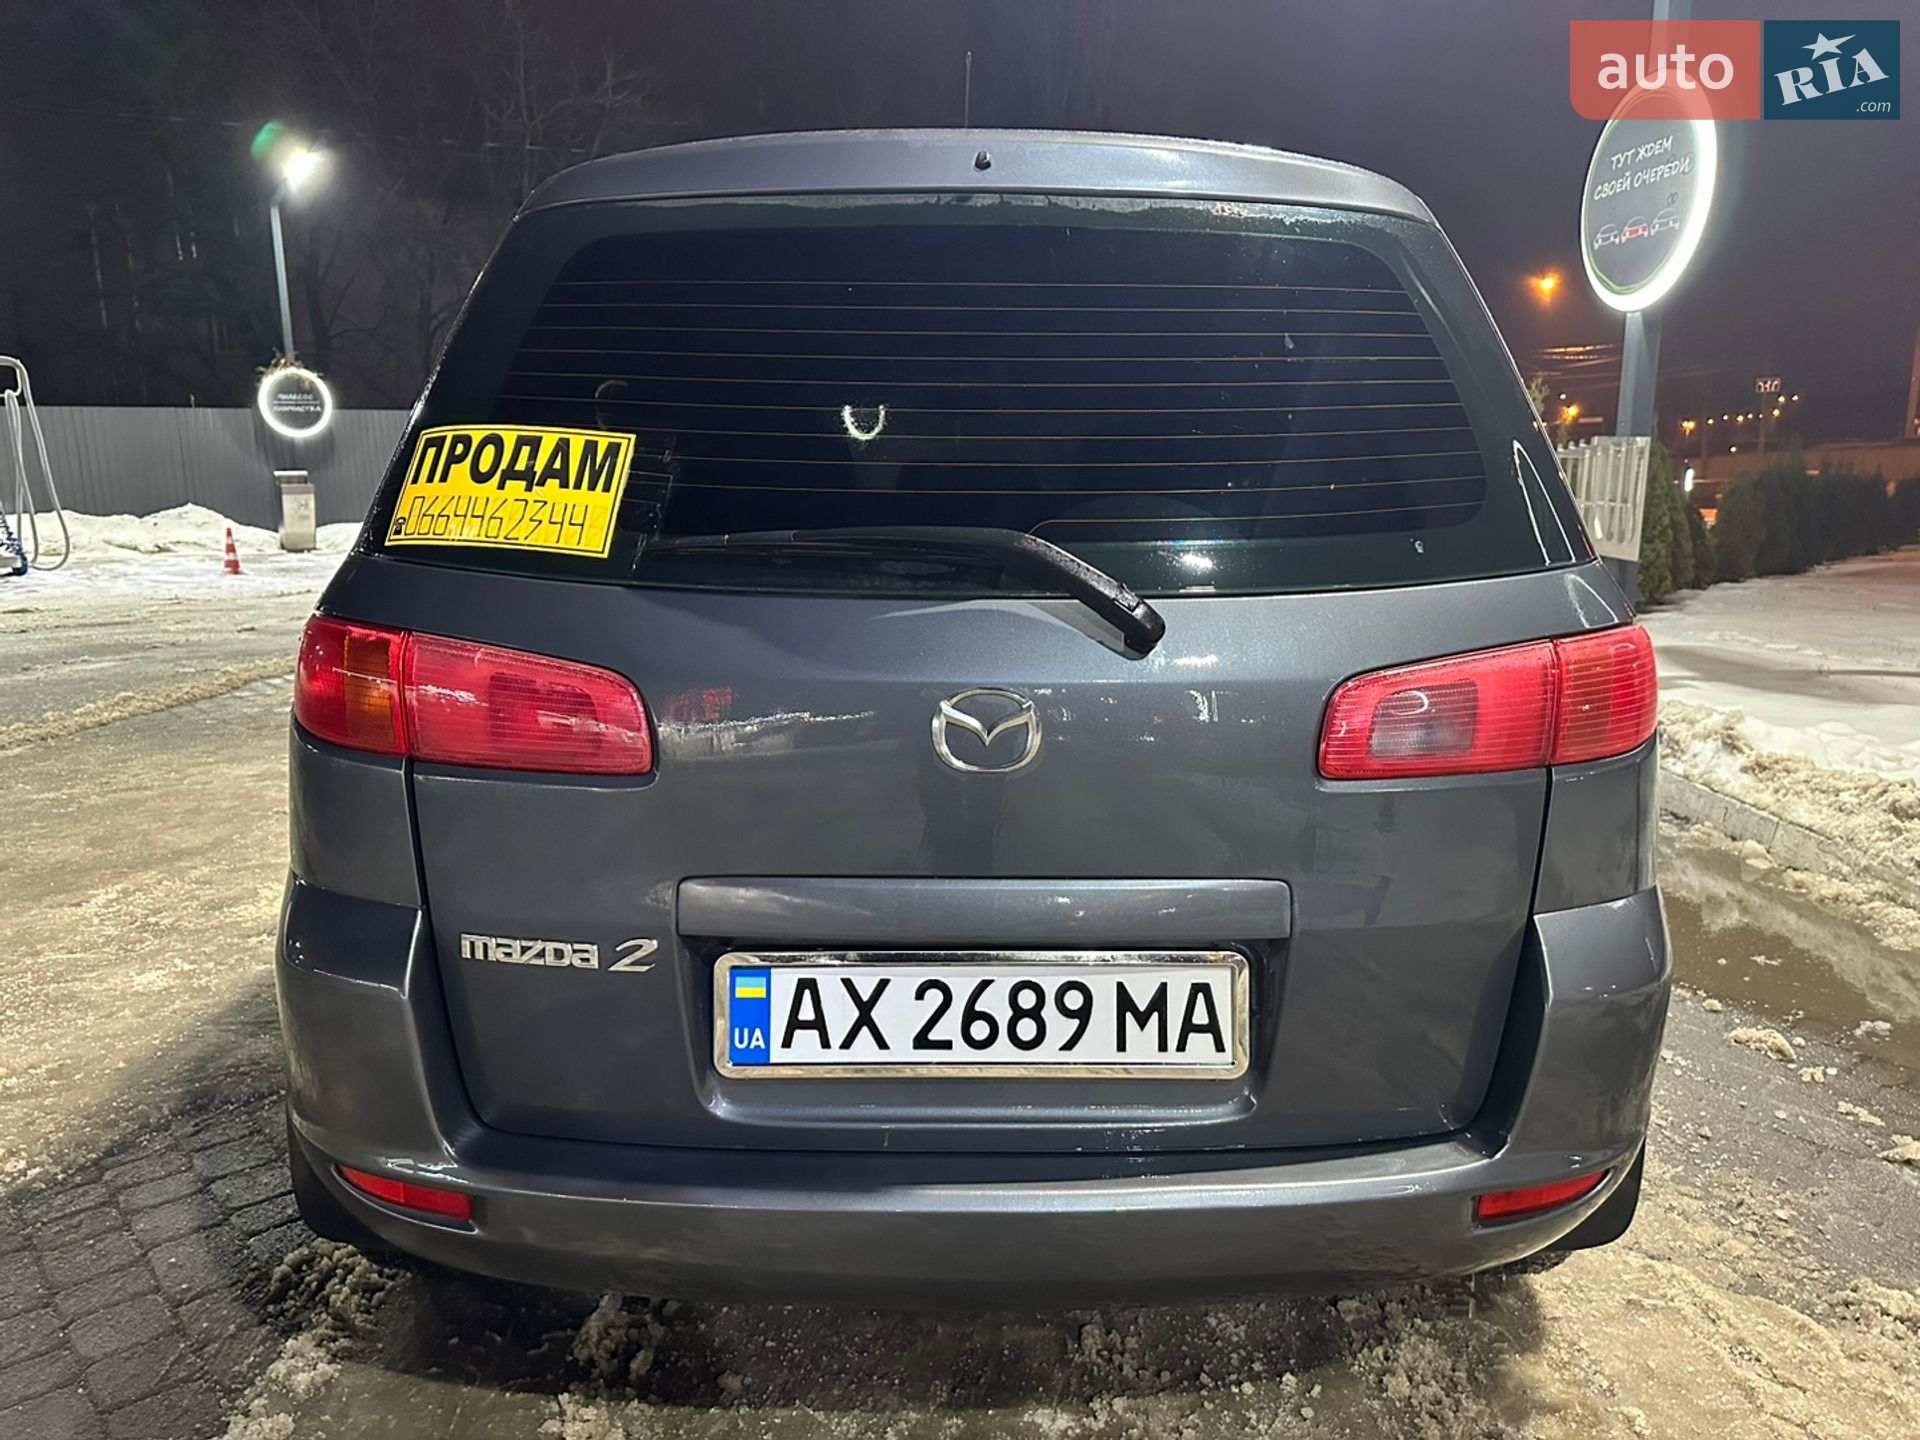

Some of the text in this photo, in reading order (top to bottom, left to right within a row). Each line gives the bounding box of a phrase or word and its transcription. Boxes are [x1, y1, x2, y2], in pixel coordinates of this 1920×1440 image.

[1611, 135, 1673, 171] ТУТ ЖДЕМ
[1593, 156, 1690, 200] СВОЕЙ ОЧЕРЕДИ
[410, 433, 623, 493] ПРОДАМ
[404, 495, 589, 546] 0664462344
[607, 938, 659, 973] 2
[780, 977, 1227, 1053] AX 2689 MA
[734, 1027, 766, 1049] UA
